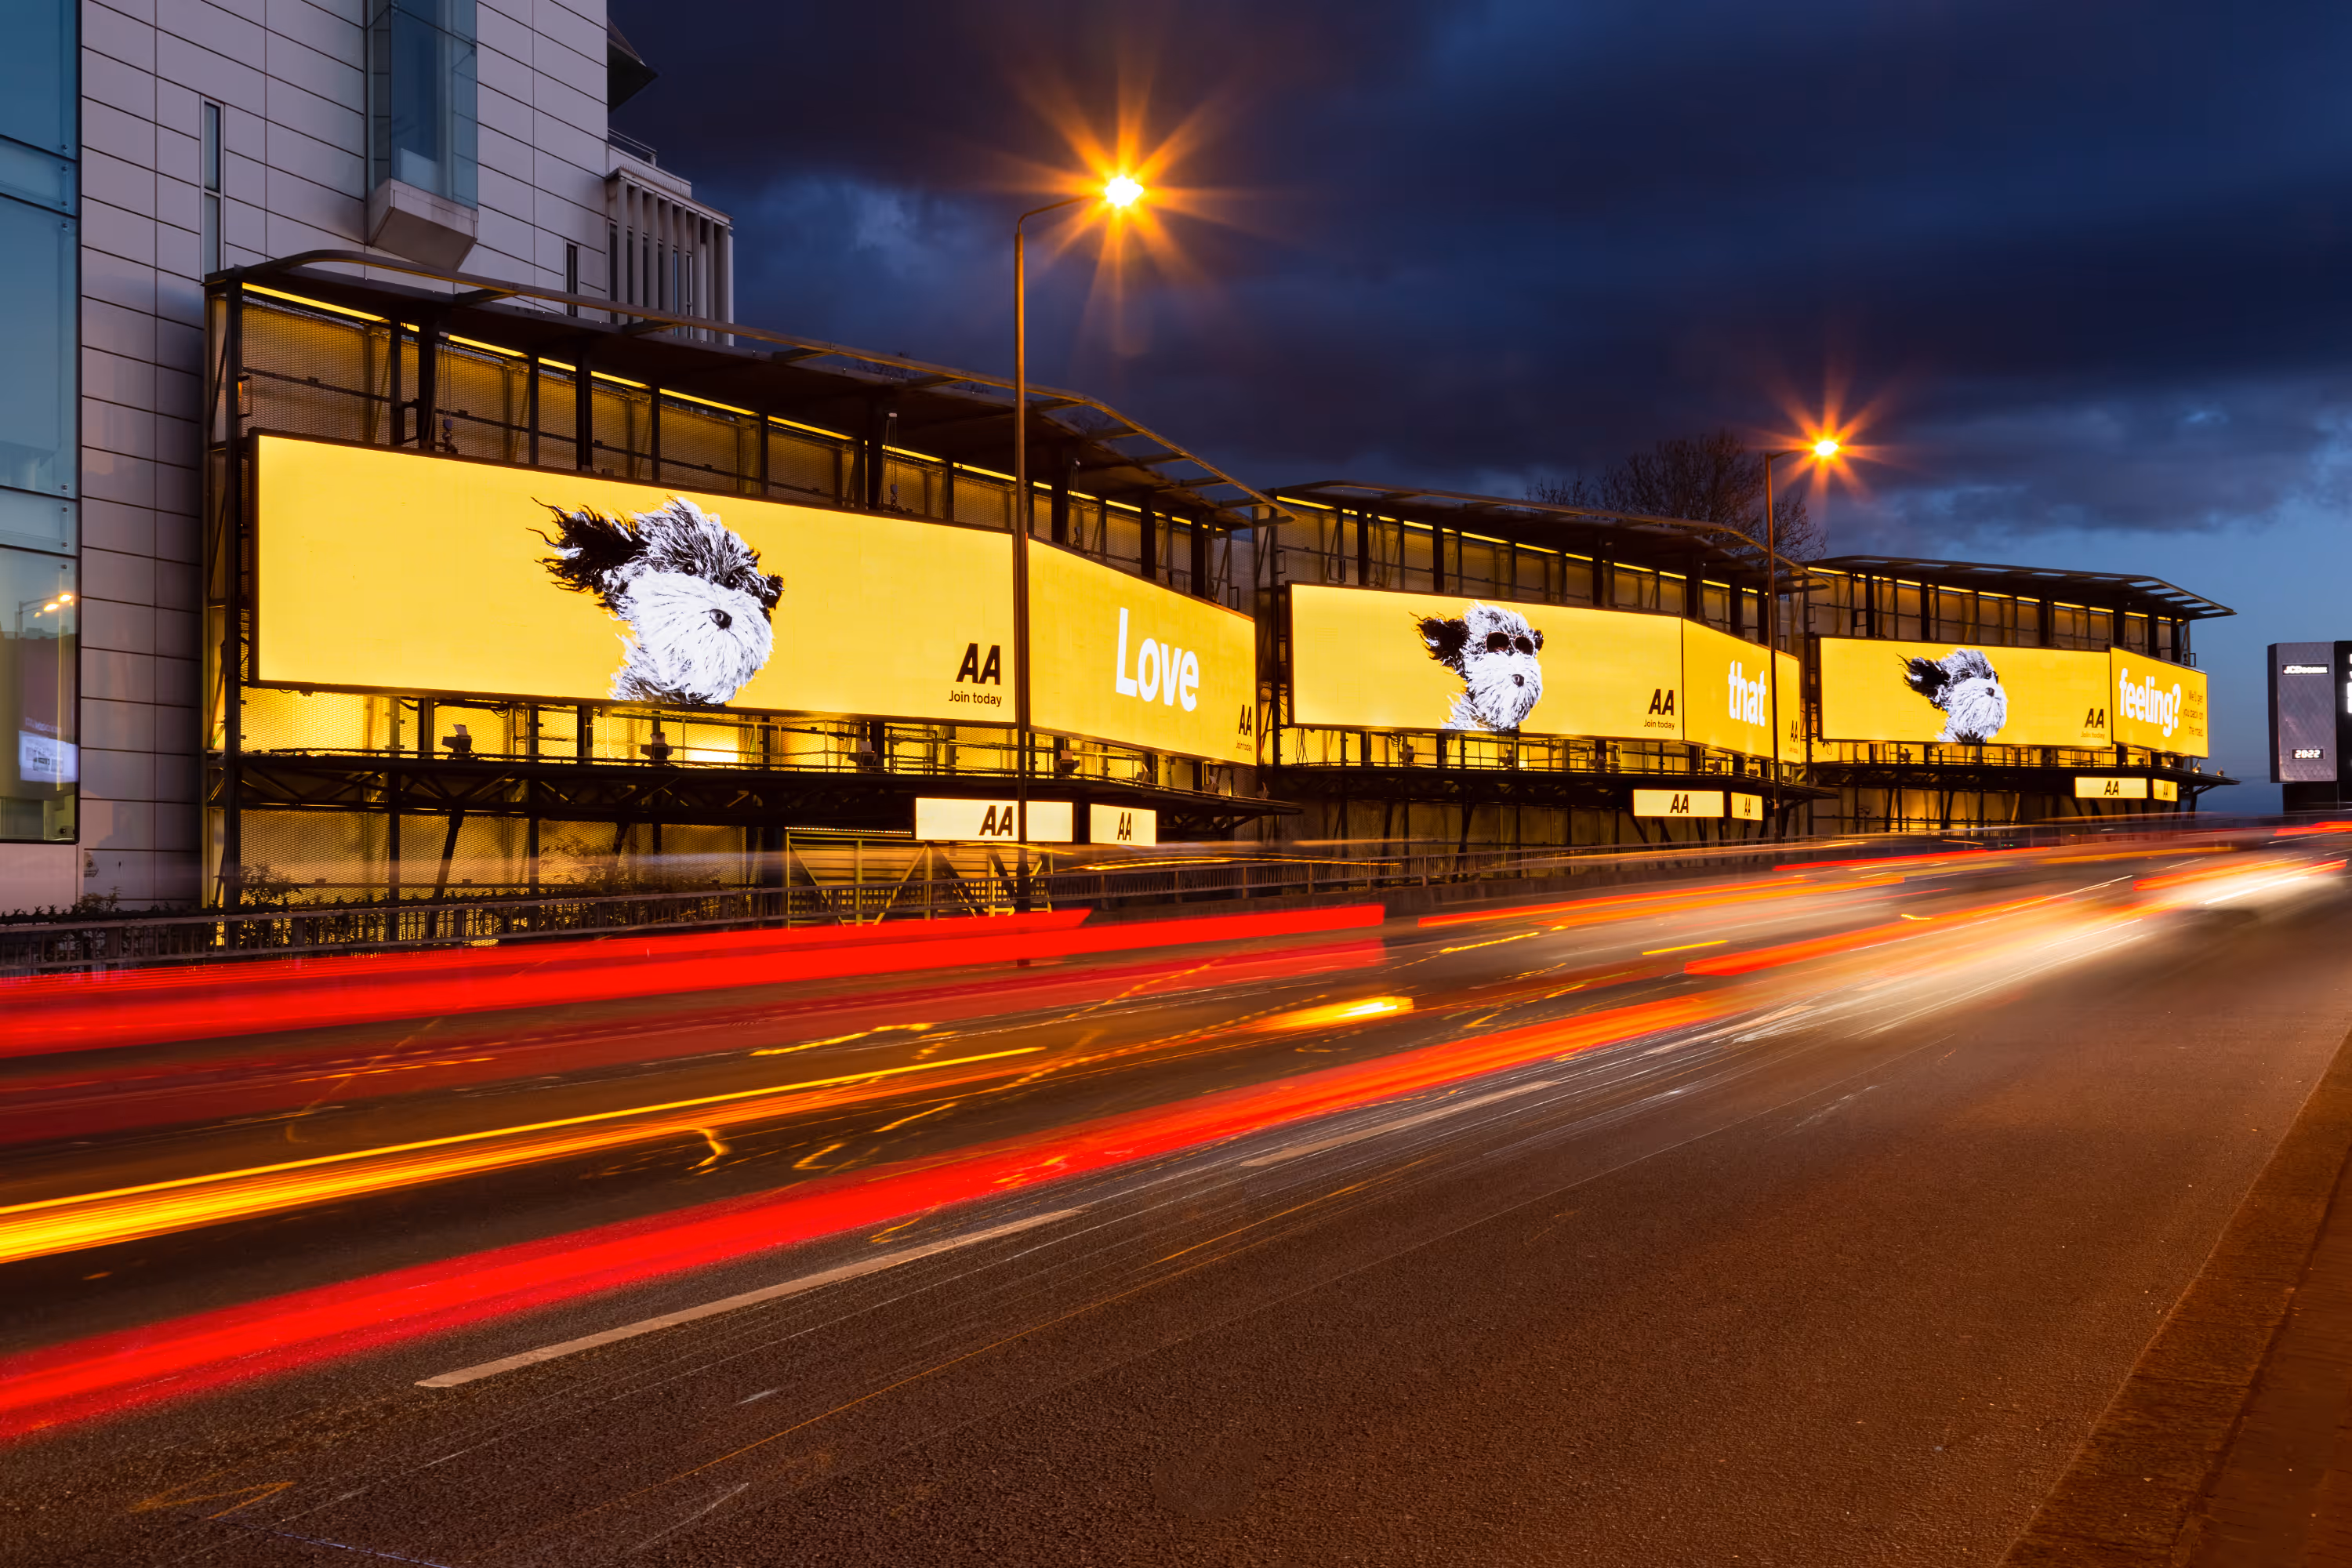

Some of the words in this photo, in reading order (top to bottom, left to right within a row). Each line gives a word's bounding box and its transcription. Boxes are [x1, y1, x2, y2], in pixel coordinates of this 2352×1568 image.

[955, 642, 1001, 685] AA
[1116, 607, 1200, 713] Love
[949, 690, 971, 703] Join
[972, 691, 1003, 707] today
[1648, 688, 1675, 716] AA
[1728, 659, 1766, 727] that
[2119, 667, 2182, 738] feeling?
[1238, 704, 1252, 737] AA
[1644, 719, 1657, 728] Join
[1657, 720, 1675, 731] today
[1790, 720, 1798, 743] AA
[2084, 708, 2104, 729] AA
[2104, 780, 2120, 796] AA
[1669, 793, 1690, 814] AA
[1744, 797, 1751, 816] AA
[978, 805, 1013, 837] AA
[1117, 811, 1131, 841] AA
